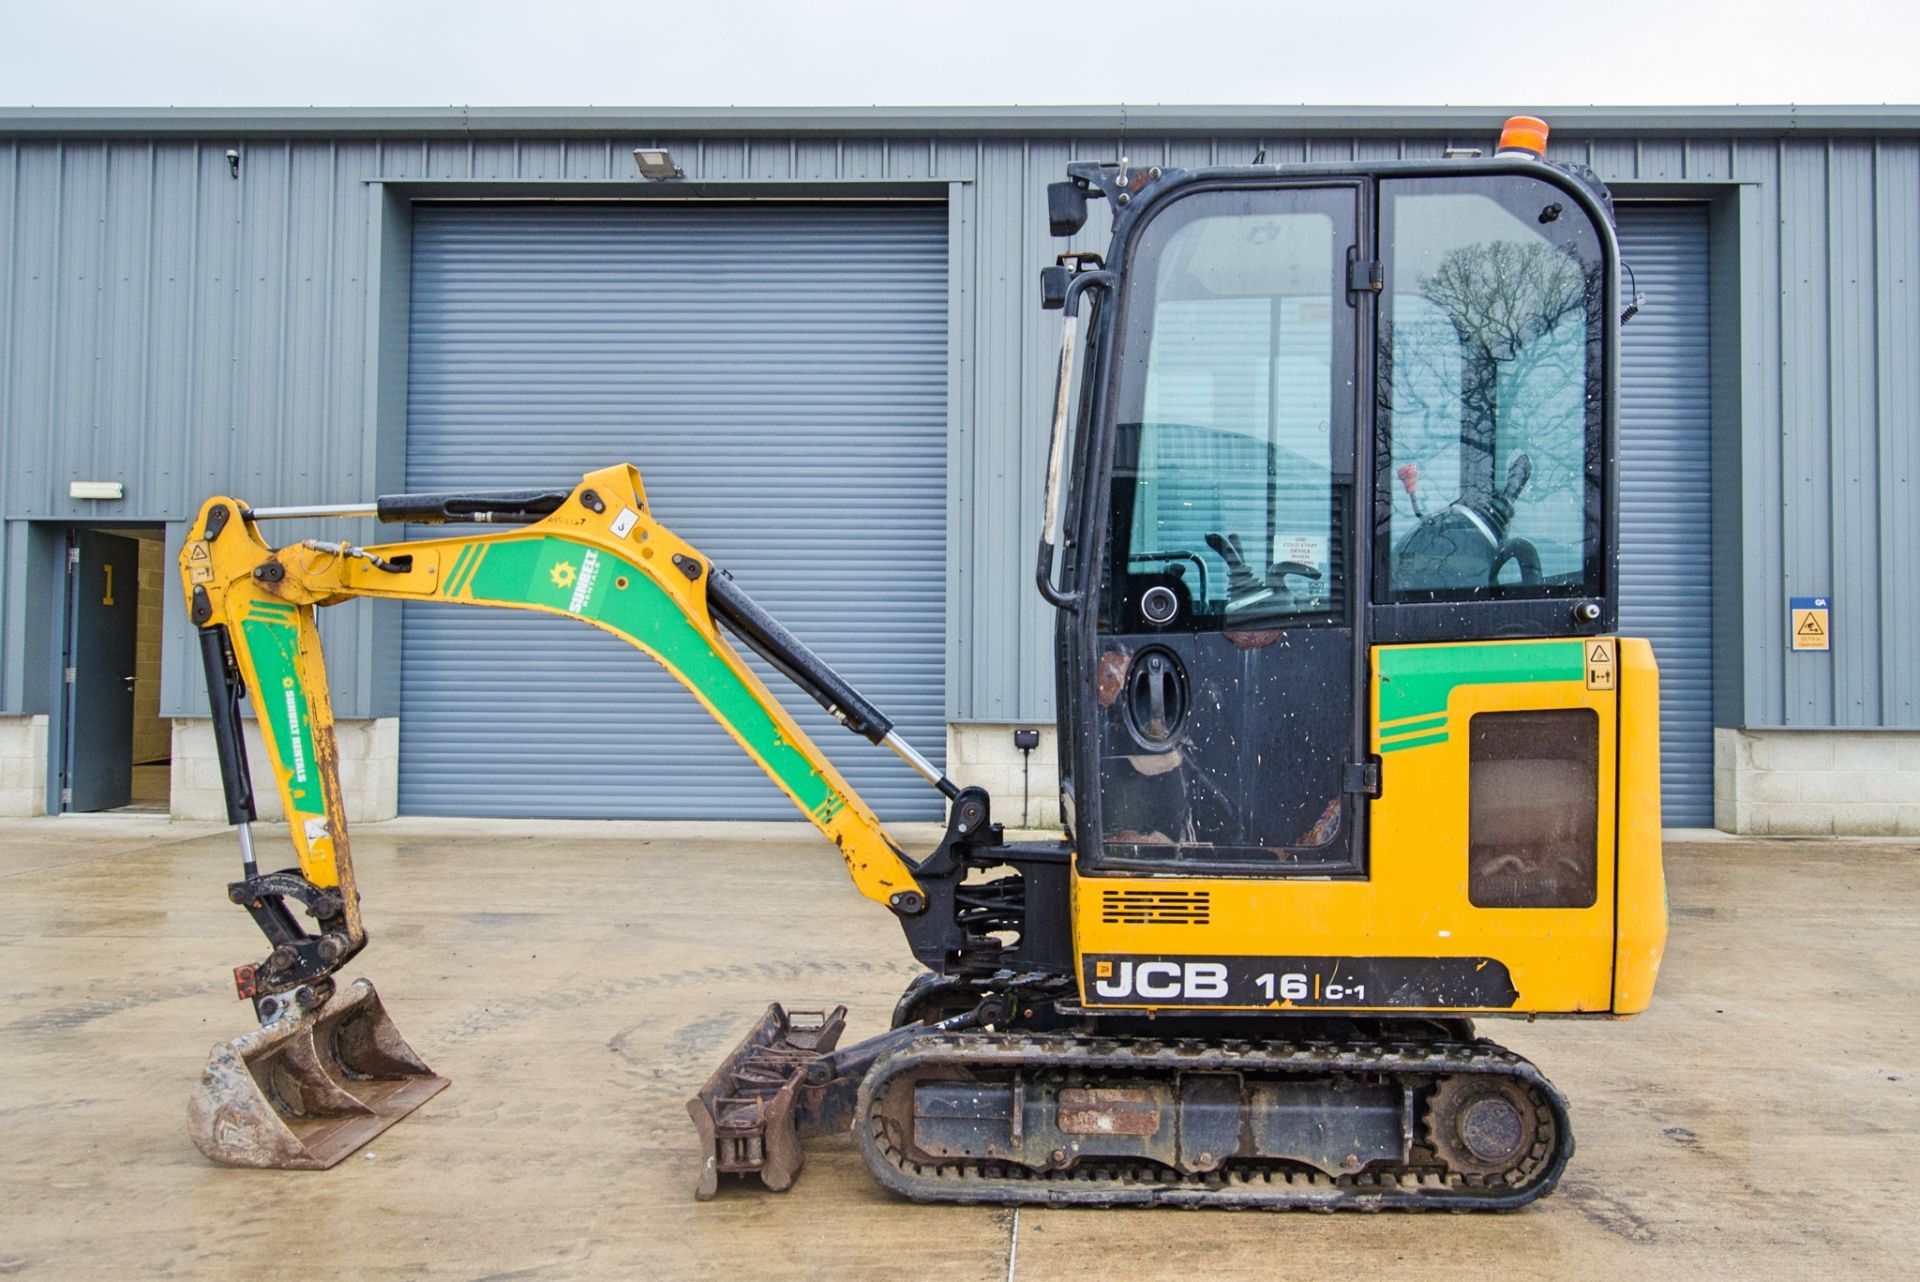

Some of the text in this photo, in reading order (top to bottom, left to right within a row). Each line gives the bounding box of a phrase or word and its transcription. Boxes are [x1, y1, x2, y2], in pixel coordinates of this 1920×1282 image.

[103, 564, 114, 606] 1
[569, 549, 598, 613] SUNBELT
[582, 560, 600, 607] RENTALS
[285, 690, 306, 782] SUNBELT RENTALS
[1096, 962, 1228, 998] JCB
[1255, 973, 1308, 999] 16
